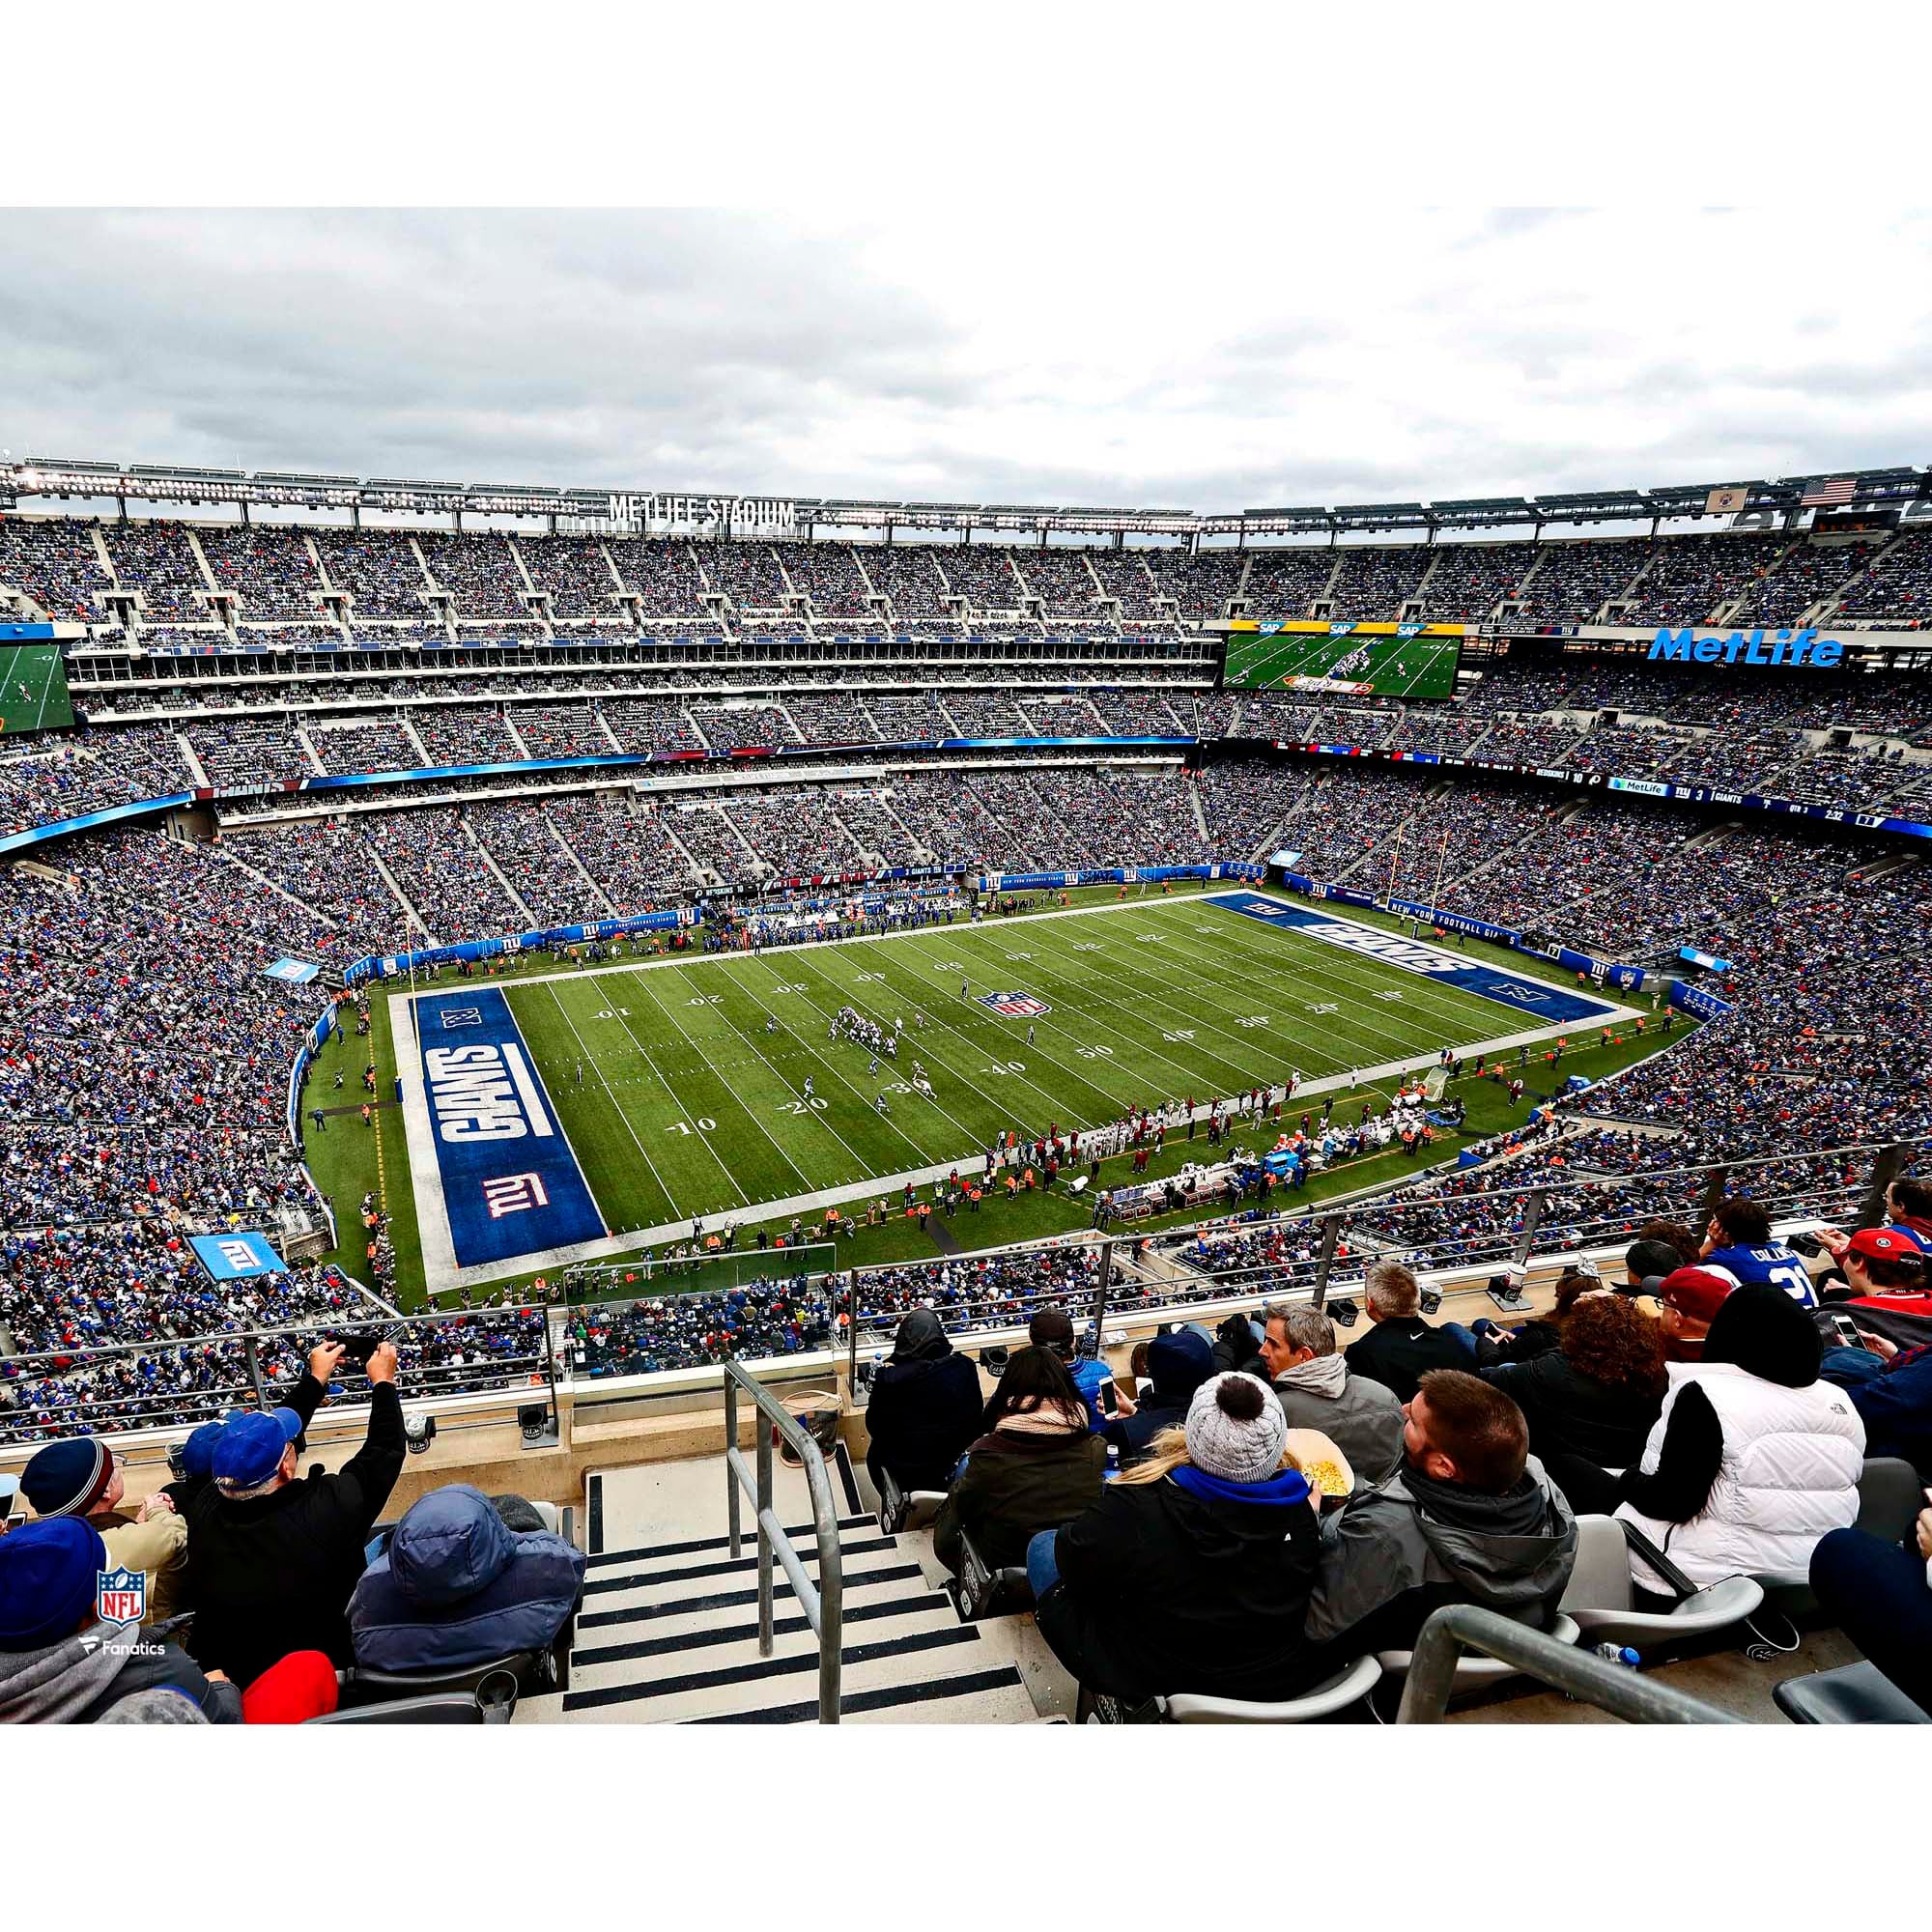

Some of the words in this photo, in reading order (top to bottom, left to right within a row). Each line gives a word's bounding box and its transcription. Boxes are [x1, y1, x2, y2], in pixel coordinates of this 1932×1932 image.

[609, 495, 698, 524] METLIFE
[706, 498, 795, 527] STADIUM
[1260, 623, 1279, 634] SAP
[1329, 624, 1351, 635] SAP
[1397, 625, 1419, 636] SAP
[1647, 628, 1844, 668] MetLife
[1536, 768, 1565, 780] REDSKINS
[1573, 773, 1583, 783] 10
[1627, 781, 1662, 794] MetLife
[1695, 790, 1703, 801] 3
[1715, 792, 1742, 805] GIANTS
[1789, 804, 1801, 813] QTR
[1825, 810, 1843, 821] 2:32
[737, 885, 744, 894] 10
[1392, 902, 1410, 915] NEW
[1414, 909, 1435, 921] YORK
[1438, 915, 1481, 934] FOOTBALL
[1303, 923, 1477, 972] GIANTS
[933, 961, 964, 972] 50
[598, 1007, 632, 1020] 10
[992, 998, 1043, 1015] NFL
[1234, 1015, 1269, 1028] 30
[1162, 1029, 1194, 1042] 40
[1075, 1044, 1114, 1059] 50
[992, 1061, 1026, 1076] 40
[425, 1044, 528, 1143] GIANTS
[785, 1096, 828, 1115] 20
[672, 1117, 717, 1136] 10
